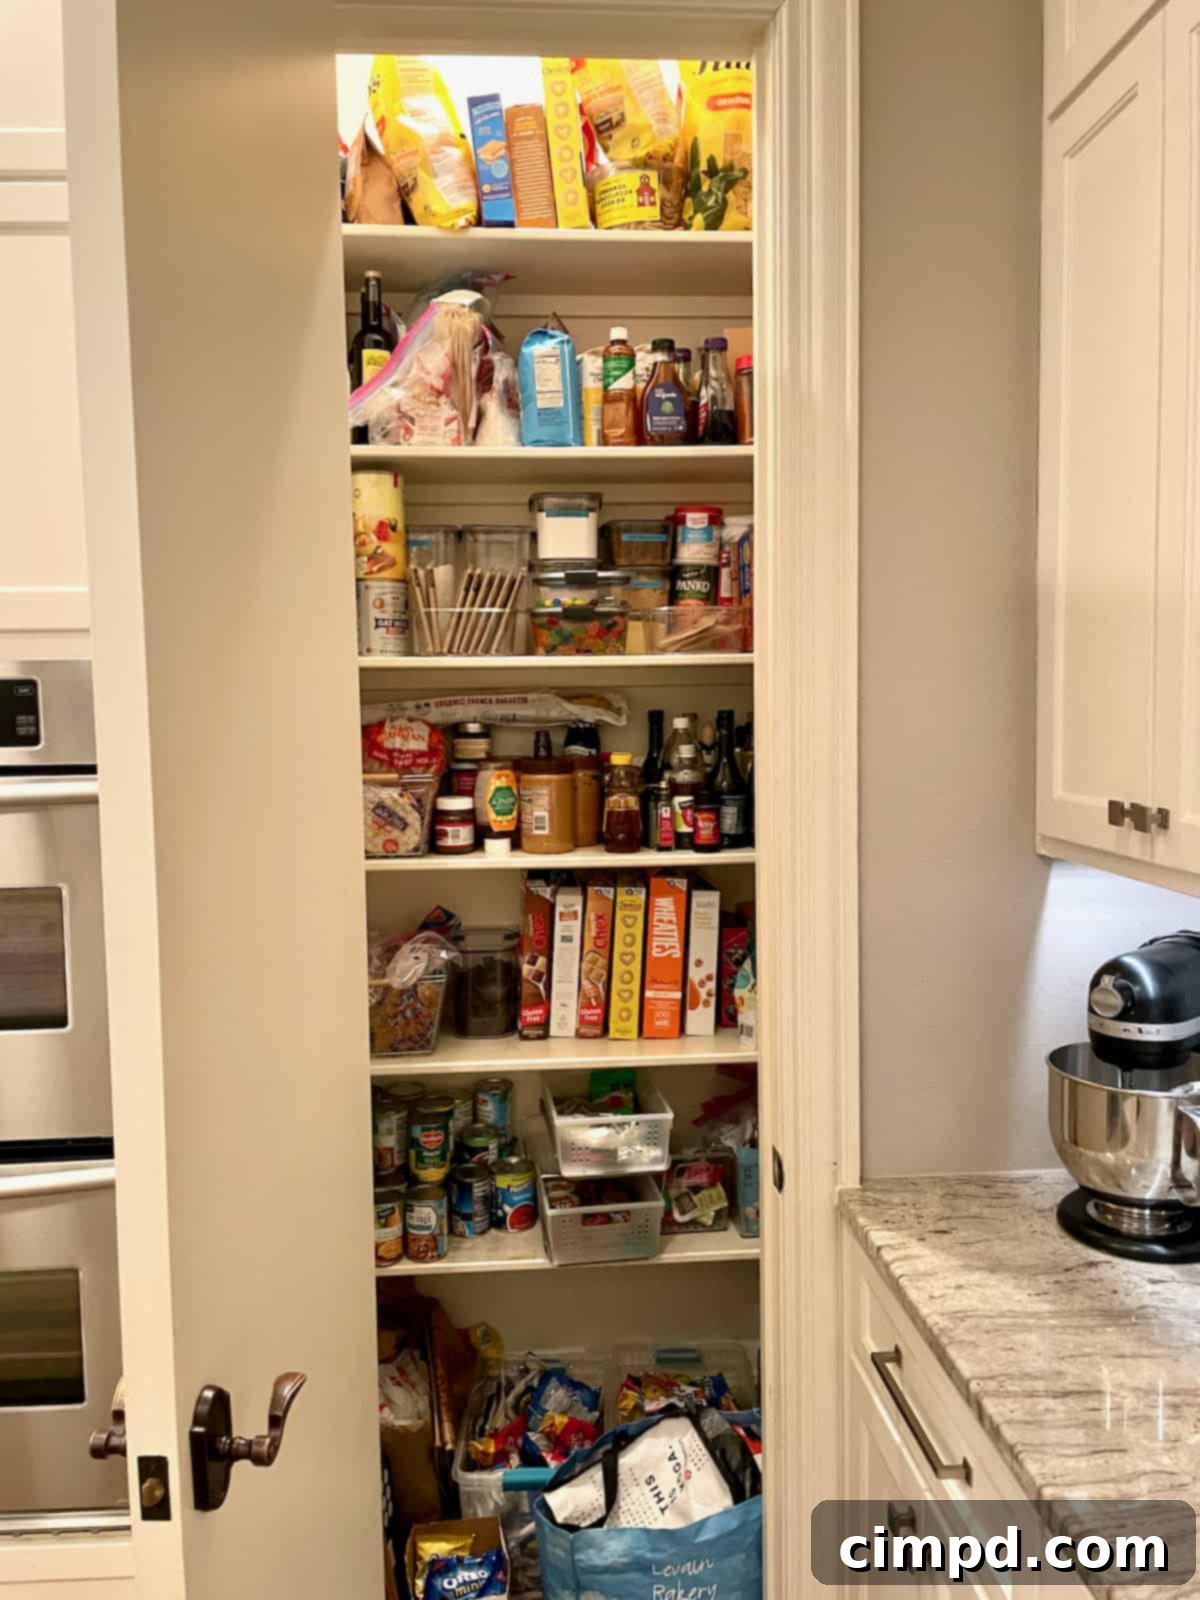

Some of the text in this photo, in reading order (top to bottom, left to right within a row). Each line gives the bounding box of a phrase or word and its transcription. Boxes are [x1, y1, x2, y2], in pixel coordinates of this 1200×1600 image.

[676, 580, 711, 593] PANKO
[593, 912, 608, 950] Chex
[652, 896, 681, 959] WHEATIES
[644, 1474, 670, 1516] THIS
[442, 1569, 489, 1590] OREO
